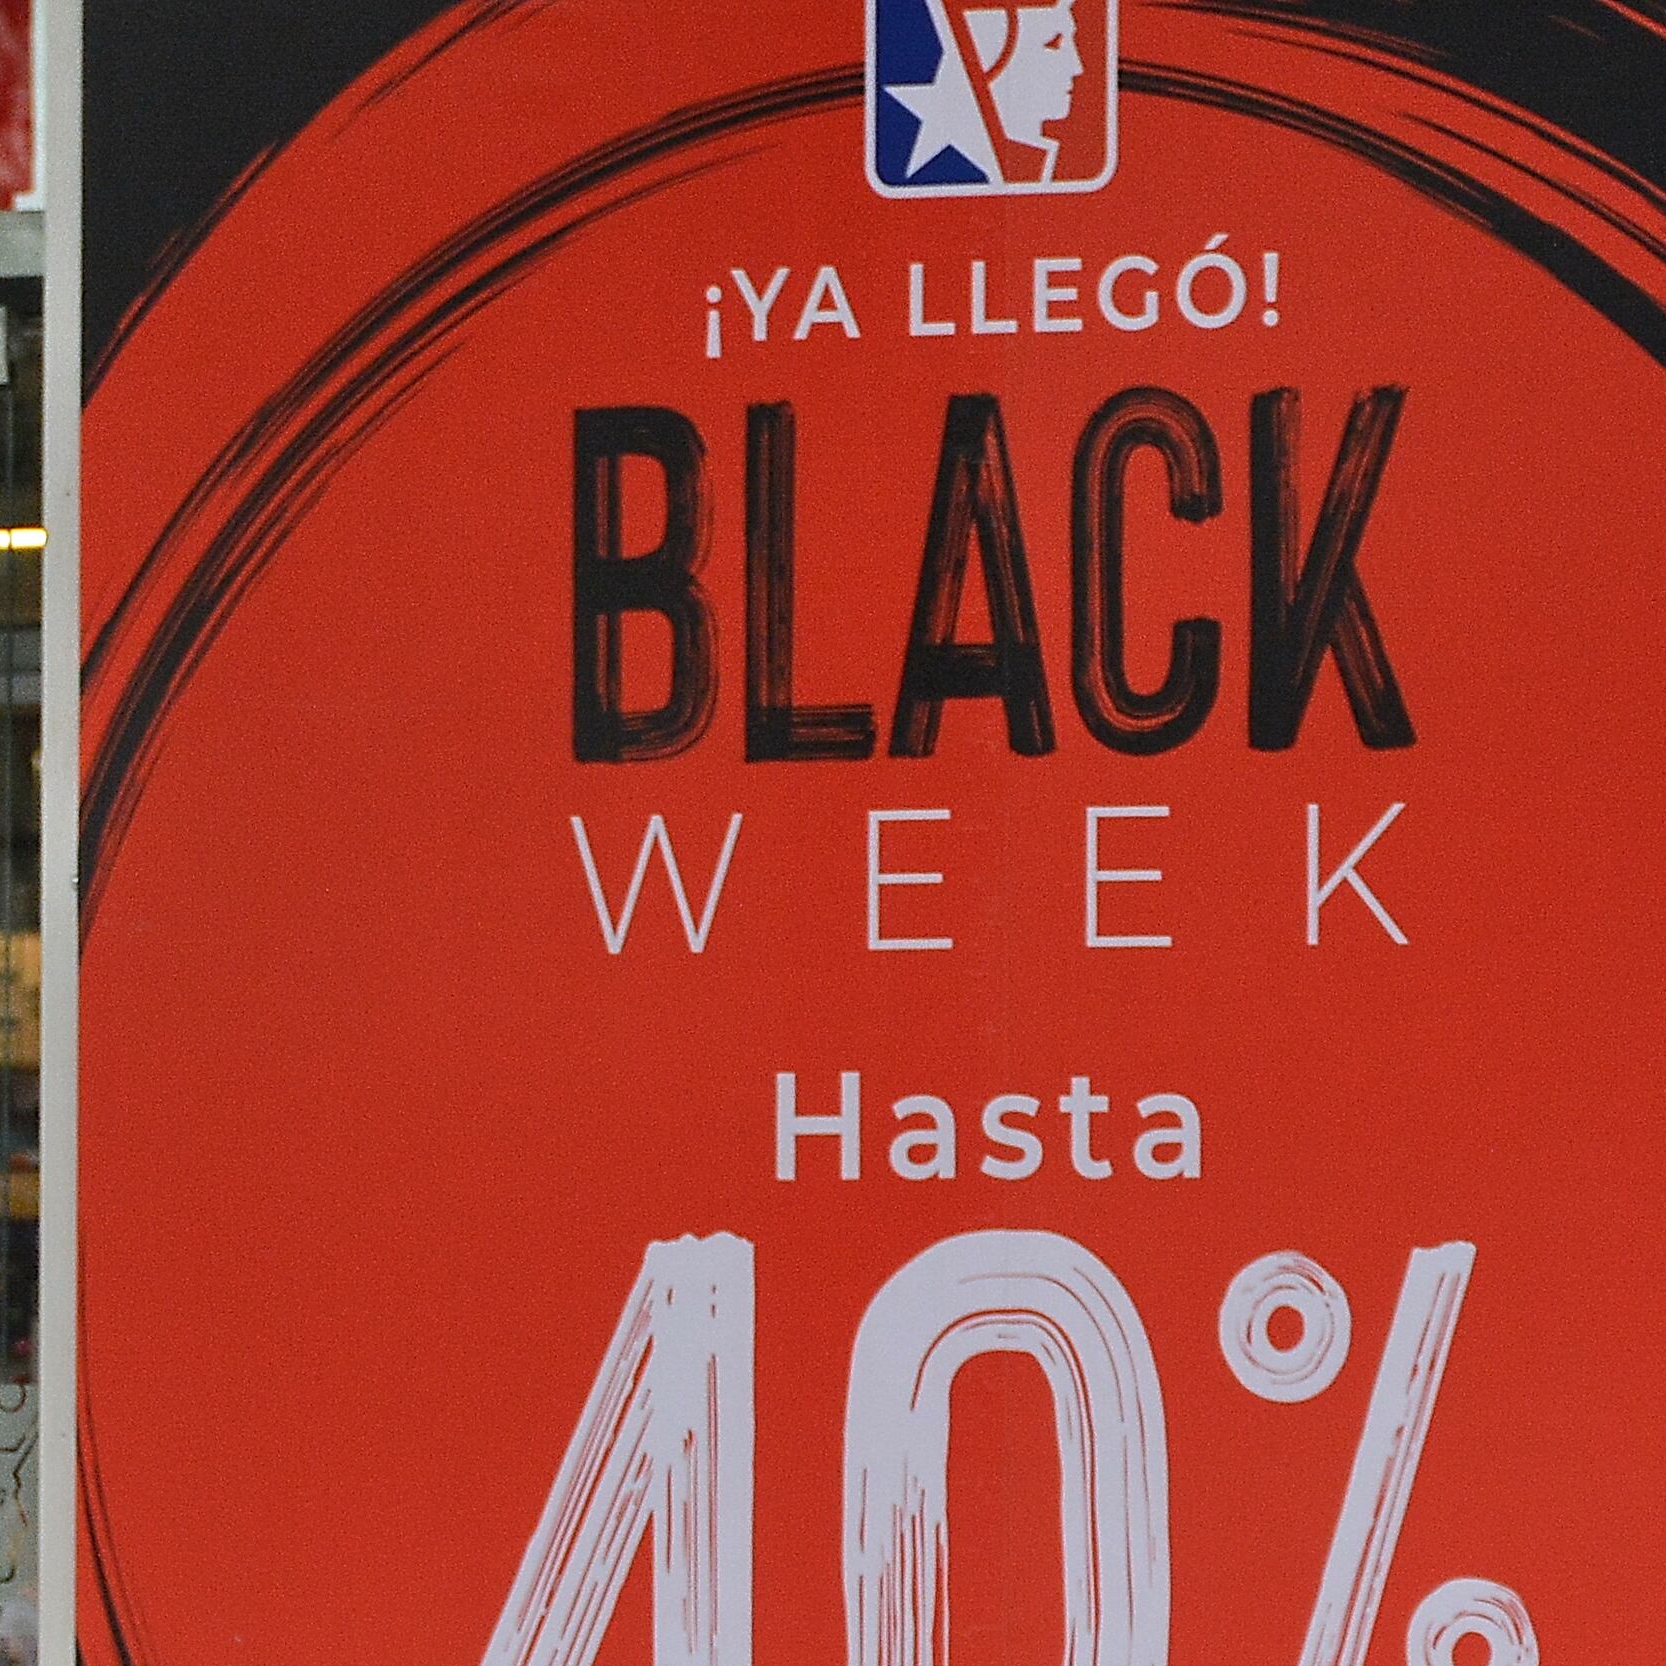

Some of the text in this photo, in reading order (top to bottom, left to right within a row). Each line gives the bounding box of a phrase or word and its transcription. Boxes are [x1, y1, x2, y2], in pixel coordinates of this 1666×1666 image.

[704, 232, 1283, 360] ¡YA LLEGÓ!
[572, 384, 1416, 763] BLACK
[570, 802, 1409, 954] WEEK
[775, 1070, 1202, 1181] Hasta
